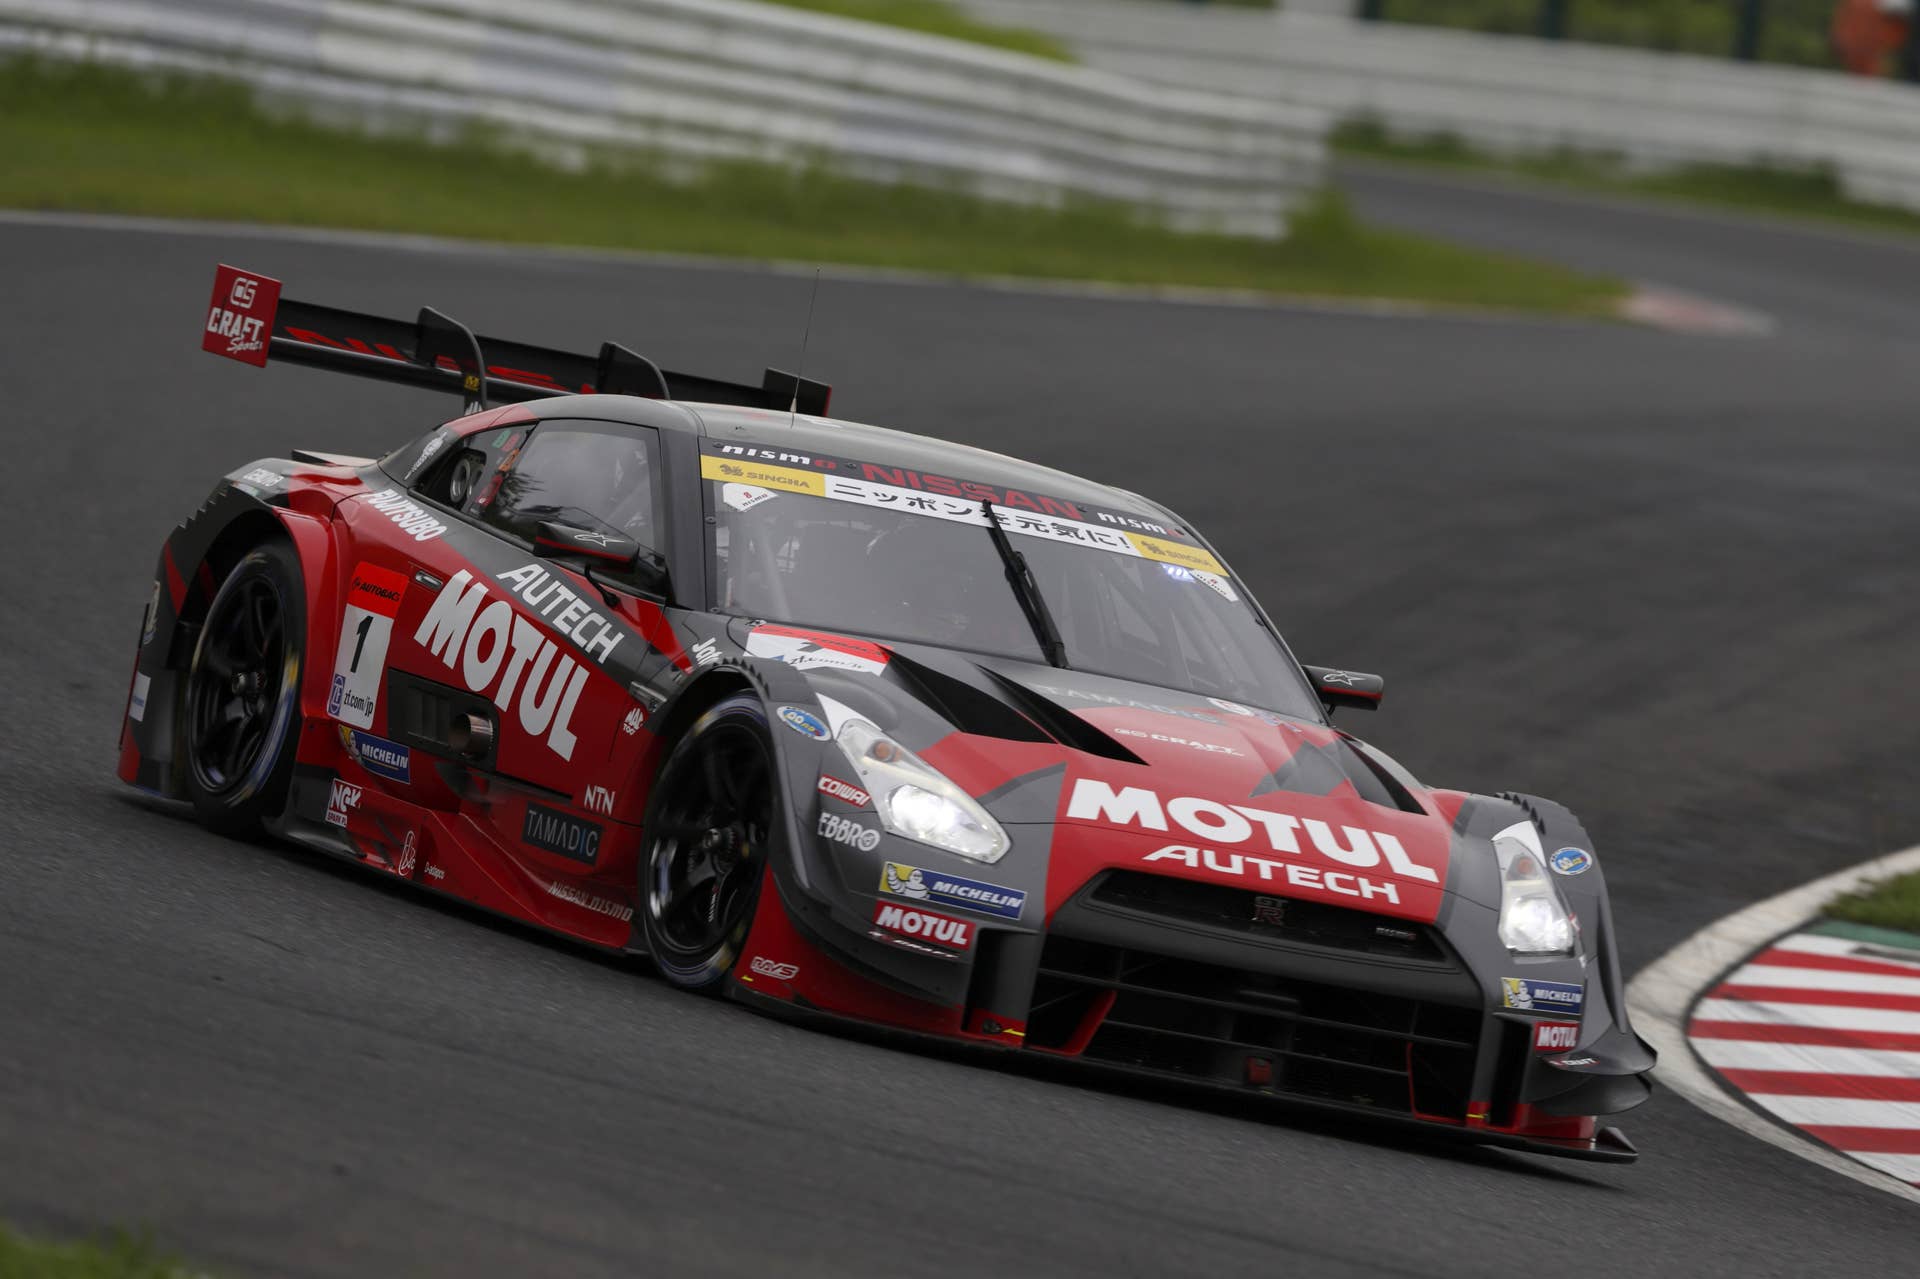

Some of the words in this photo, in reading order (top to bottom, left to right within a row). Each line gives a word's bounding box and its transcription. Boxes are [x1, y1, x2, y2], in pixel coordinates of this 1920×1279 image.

[206, 307, 264, 341] CRAFT
[722, 445, 836, 470] nismo
[861, 464, 1085, 521] NISSAN
[1096, 512, 1184, 538] nismo
[746, 471, 810, 488] SINGHA
[496, 563, 625, 665] AUTECH
[350, 615, 374, 674] 1
[413, 568, 591, 763] MOTUL
[361, 743, 409, 769] MICHELIN
[330, 784, 361, 812] NGK
[584, 785, 616, 816] NTN
[817, 777, 871, 806] COIWAI
[527, 809, 598, 857] TAMADIC
[817, 811, 880, 851] EBBRO
[1066, 778, 1440, 883] MOTUL
[1143, 844, 1401, 905] AUTECH
[932, 880, 1022, 908] MICHELIN
[876, 906, 968, 945] MOTUL
[1534, 987, 1582, 1003] MICHELIN
[1536, 1026, 1577, 1048] MOTUL
